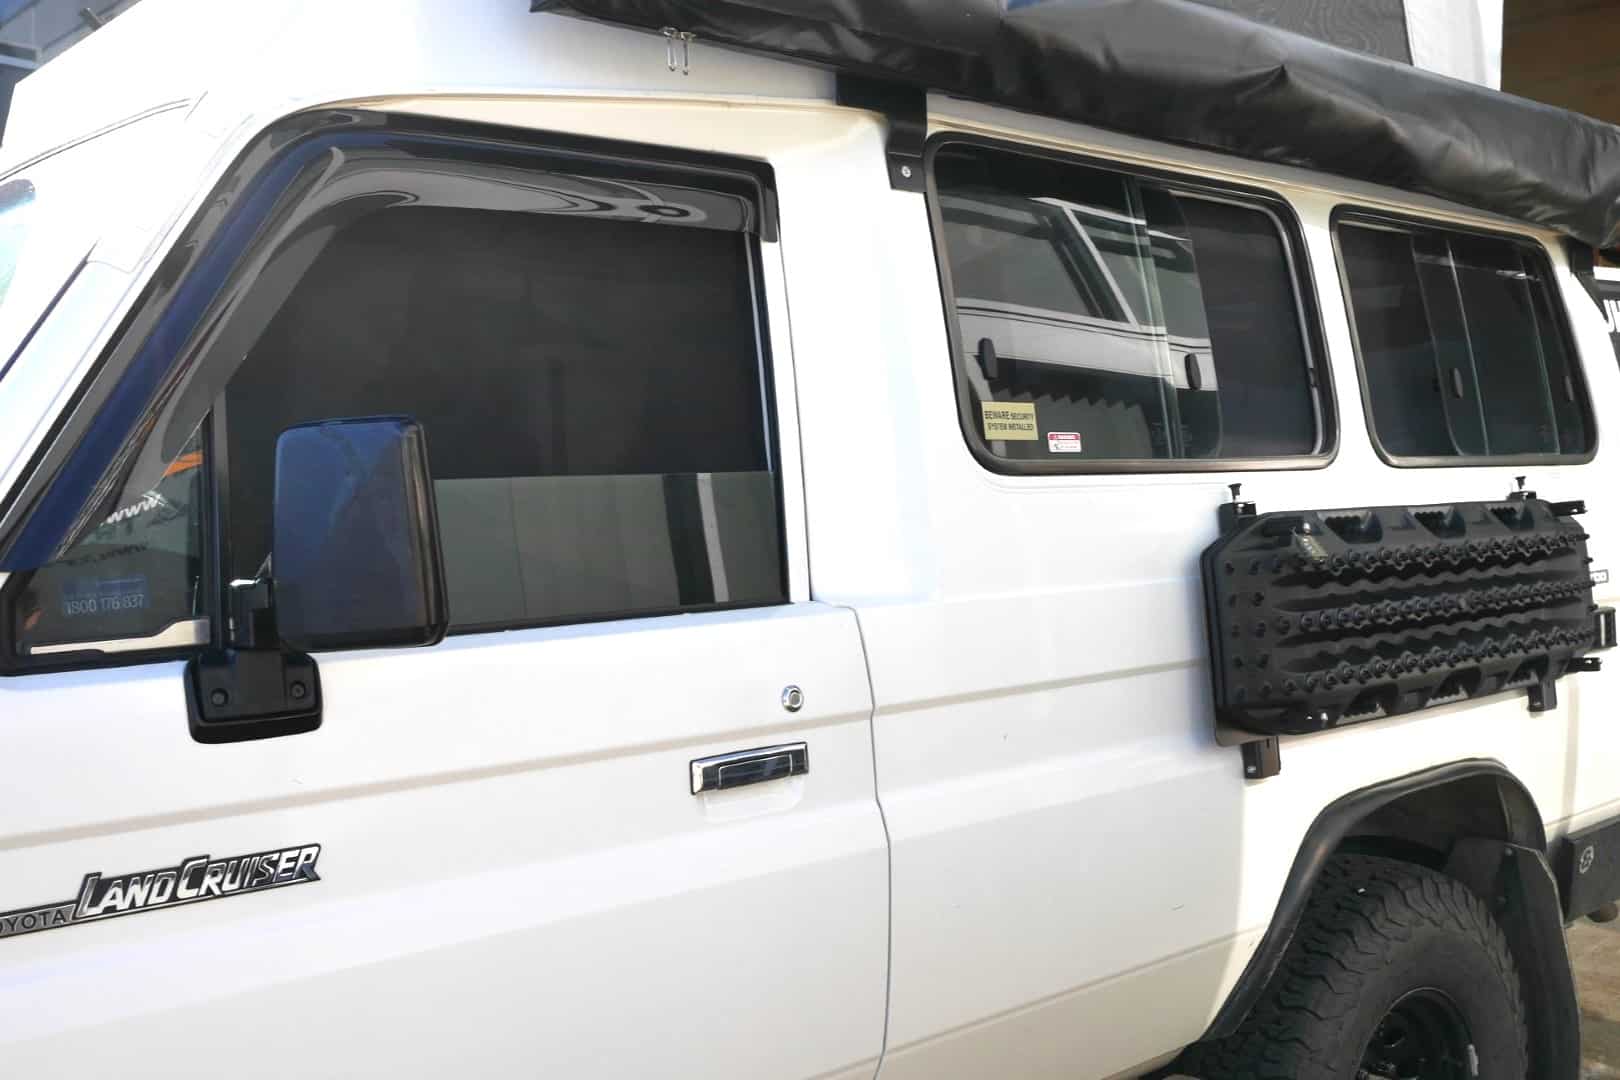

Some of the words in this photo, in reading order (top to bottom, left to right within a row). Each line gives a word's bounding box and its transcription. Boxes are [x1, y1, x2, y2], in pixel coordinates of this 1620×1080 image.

[984, 410, 1009, 420] BEWARE
[1010, 412, 1034, 421] SECURITY
[987, 422, 1008, 431] SYSTEM
[1008, 422, 1034, 431] INSTALLED
